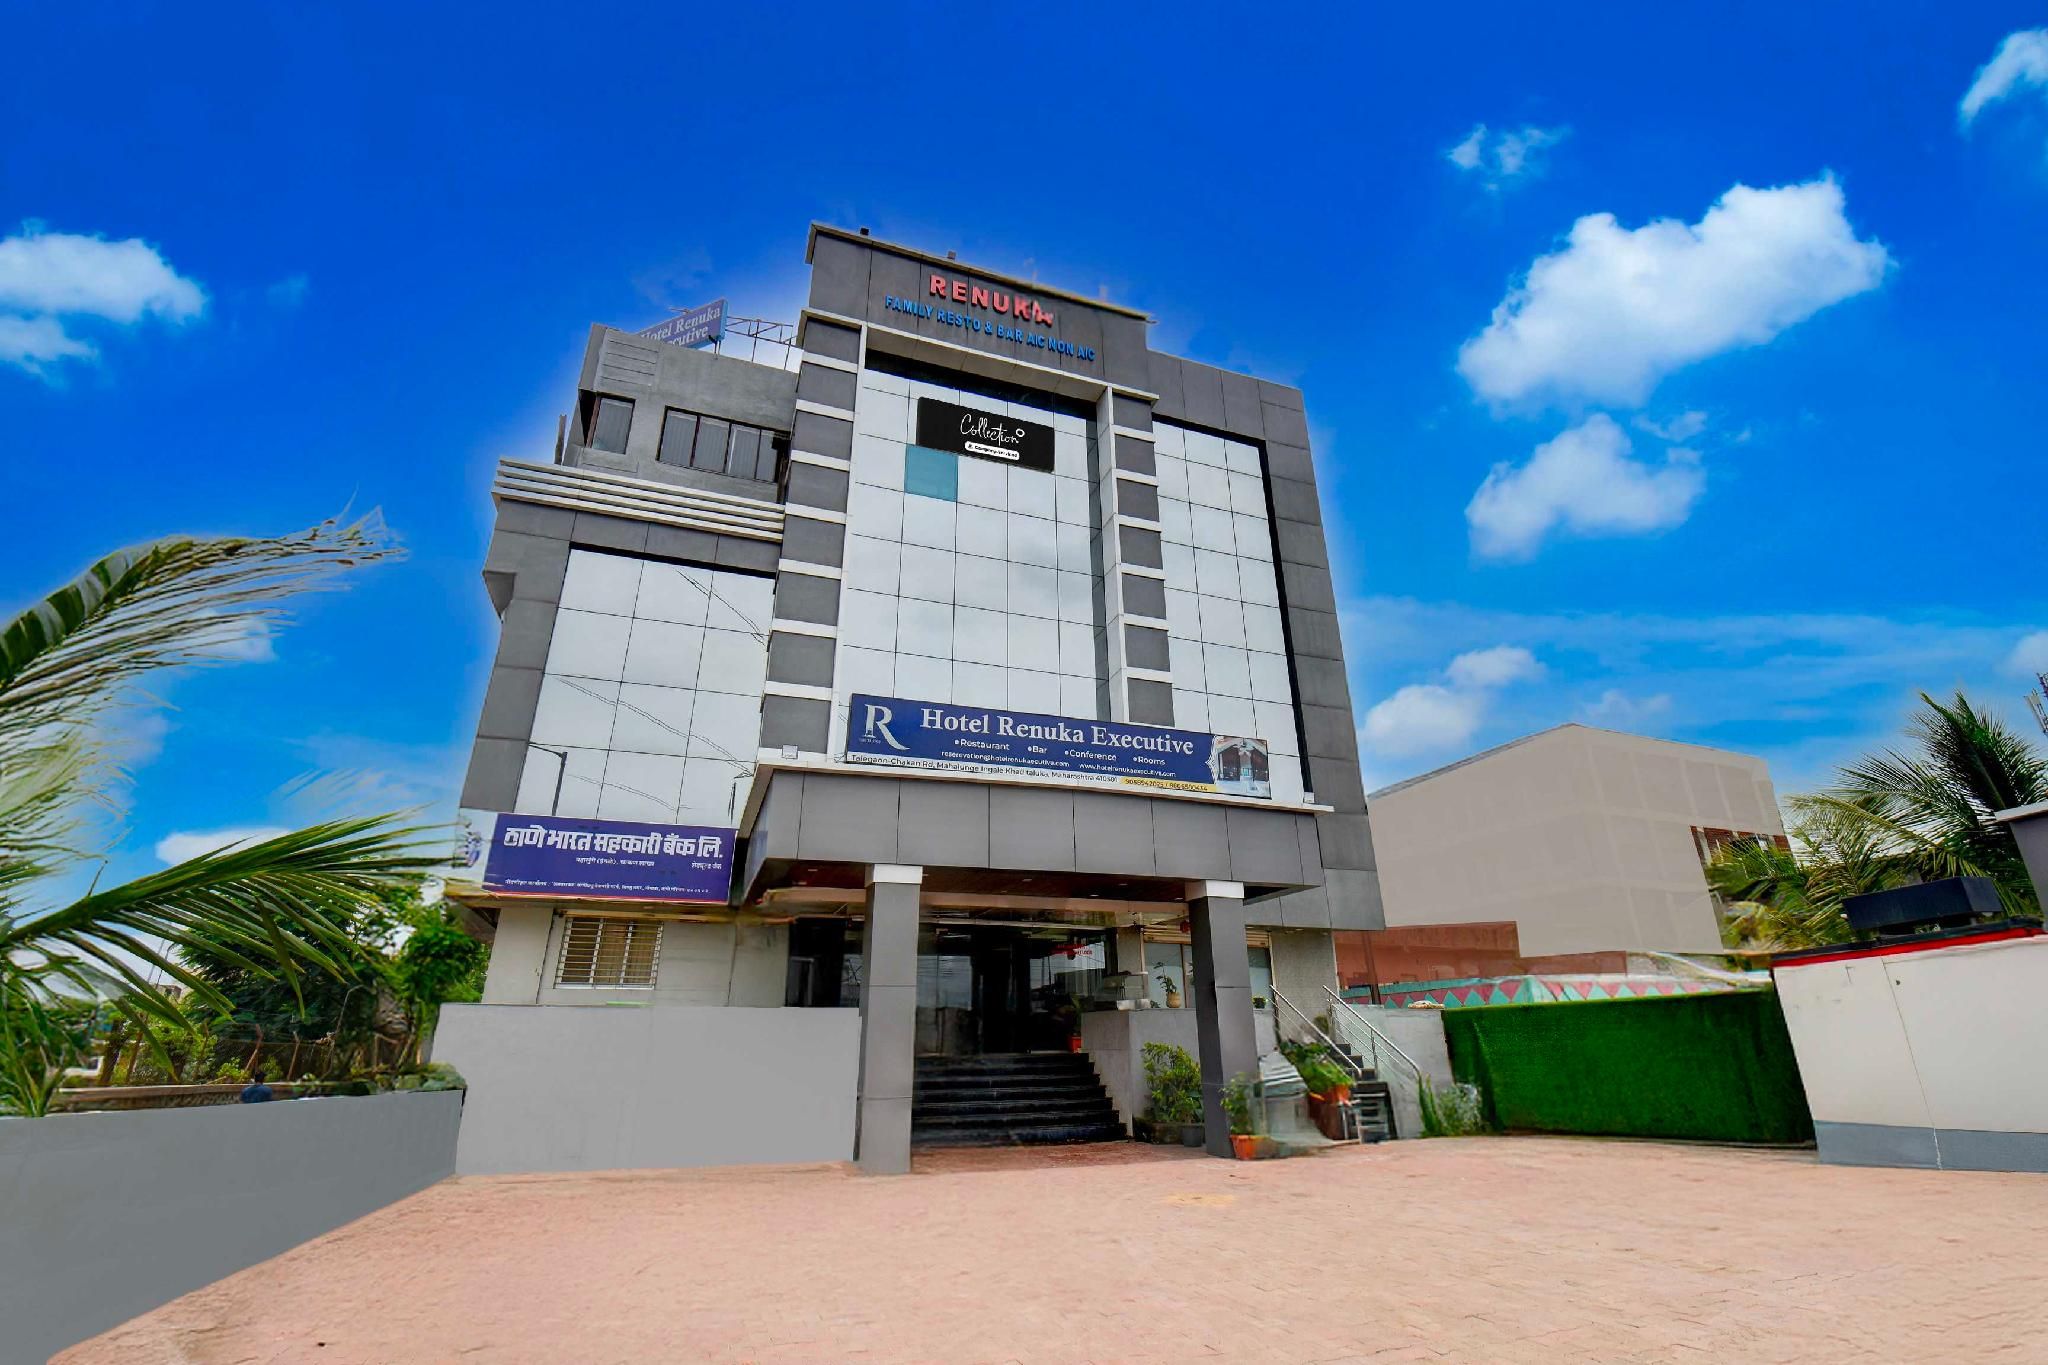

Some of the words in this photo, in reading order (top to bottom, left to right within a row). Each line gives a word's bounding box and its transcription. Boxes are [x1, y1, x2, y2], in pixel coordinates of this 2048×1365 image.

[673, 307, 721, 335] Renuka
[885, 295, 933, 320] FAMILY
[937, 308, 981, 332] RESTO
[985, 321, 993, 335] &
[997, 324, 1023, 344] BAR
[1048, 336, 1074, 357] NON
[960, 413, 1019, 447] Collection
[863, 704, 911, 751] R
[920, 708, 990, 734] Hotel
[997, 716, 1085, 744] Renuka
[1091, 726, 1194, 755] Executive
[961, 738, 1010, 751] Restaurant
[1032, 745, 1047, 754] Bar
[1069, 749, 1117, 761] Conference
[1138, 756, 1166, 766] Rooms
[503, 824, 548, 848] ठाणे
[547, 830, 593, 851] भारत
[594, 832, 663, 854] सहकारी
[663, 833, 697, 856] बँक
[697, 835, 723, 858] लि.
